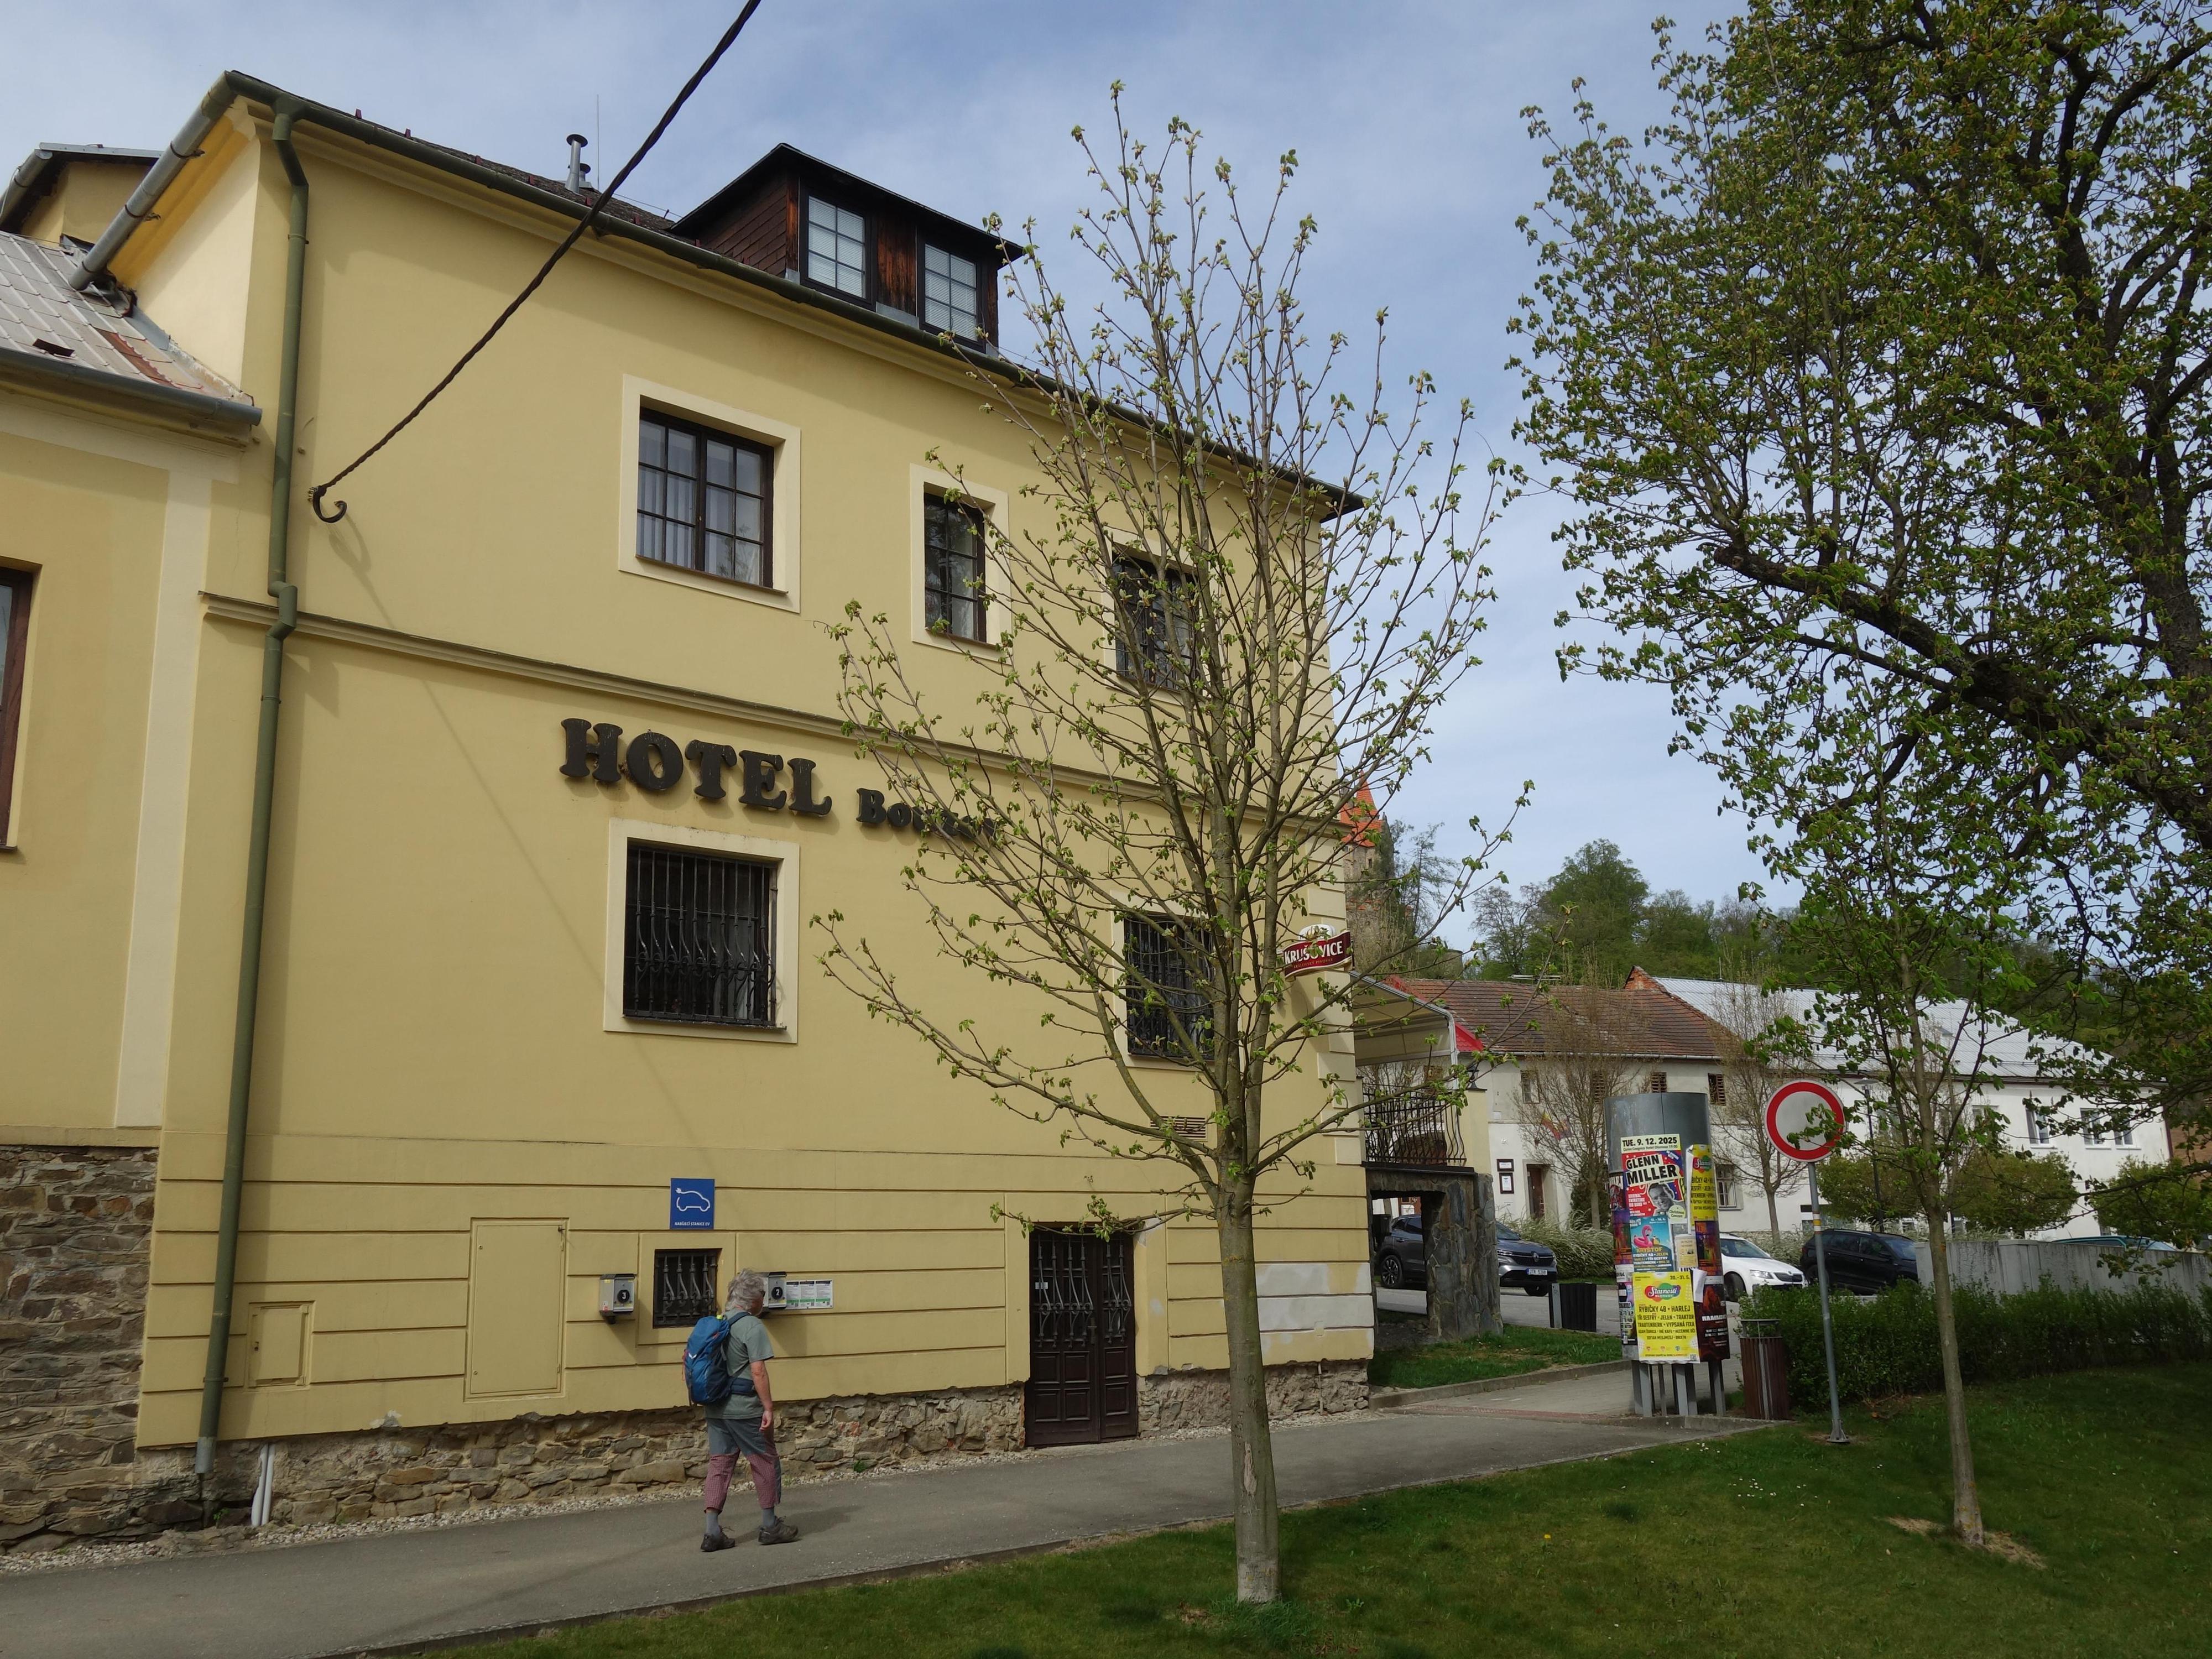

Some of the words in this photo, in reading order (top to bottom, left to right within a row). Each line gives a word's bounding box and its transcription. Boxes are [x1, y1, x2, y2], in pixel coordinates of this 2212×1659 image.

[559, 718, 832, 817] HOTEL
[1626, 1154, 1660, 1170] GLENN
[1626, 1165, 1678, 1185] MILLER
[1648, 1287, 1677, 1297] Slavnosti
